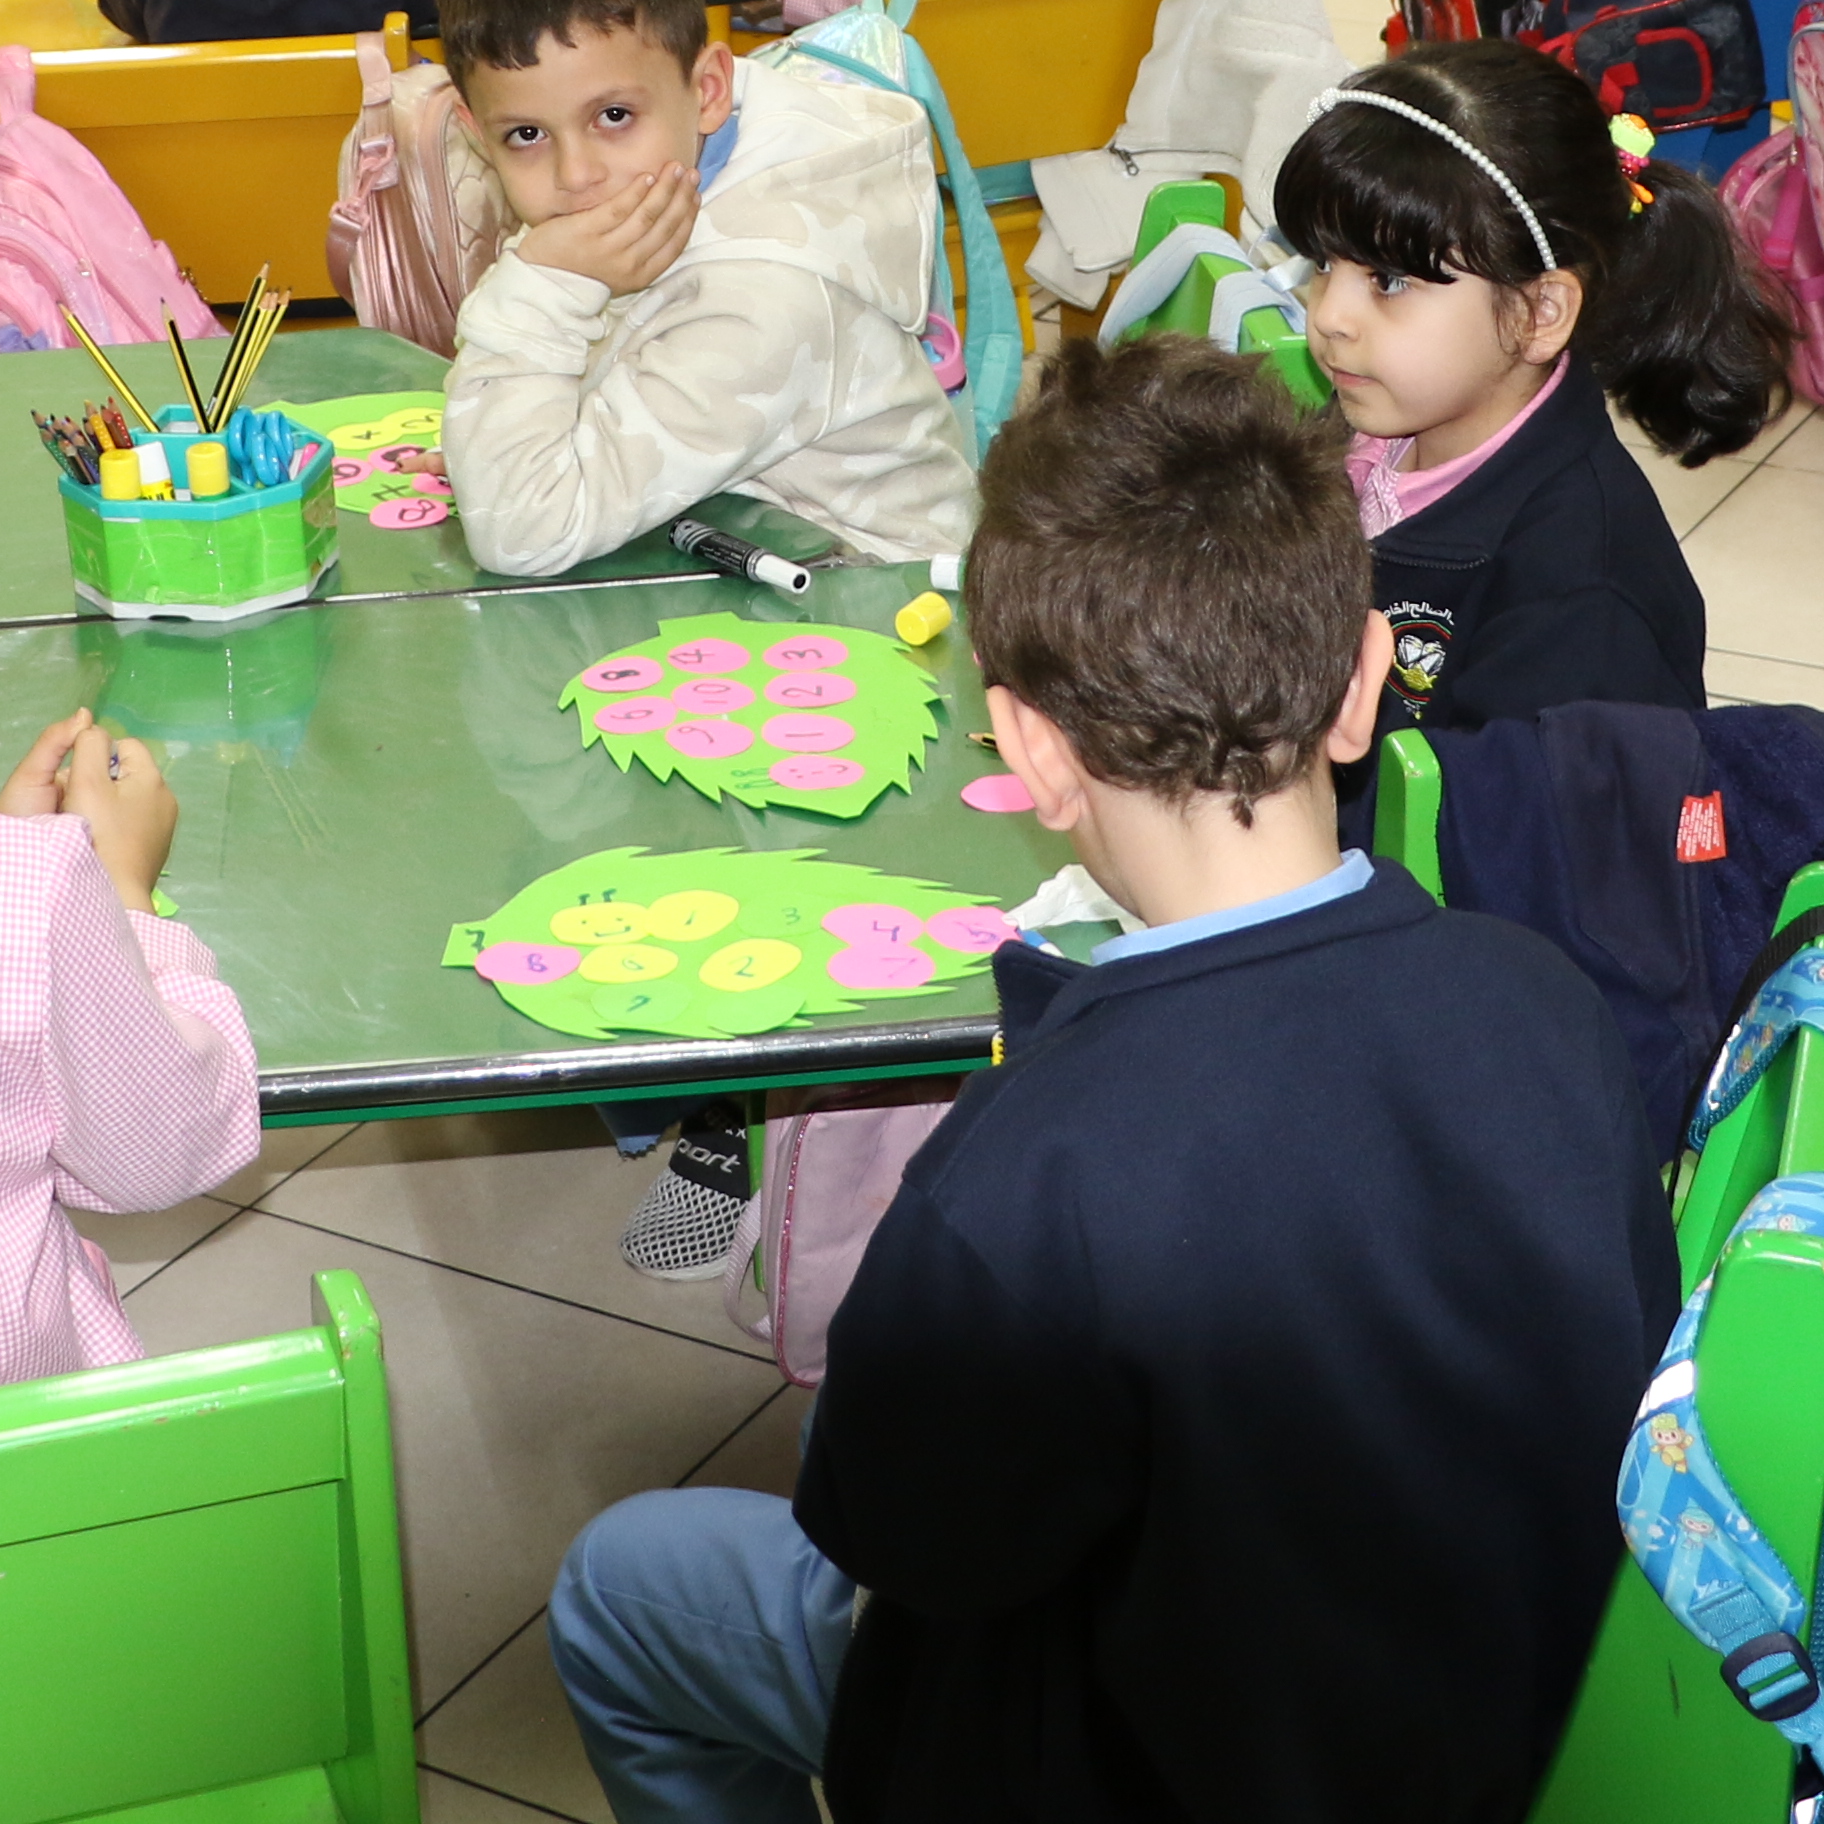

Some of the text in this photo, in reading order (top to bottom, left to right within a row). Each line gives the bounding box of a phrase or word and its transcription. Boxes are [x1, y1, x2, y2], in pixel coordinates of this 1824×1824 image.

[782, 647, 823, 660] 3
[781, 685, 823, 698] 2
[782, 906, 801, 925] 3
[873, 919, 900, 942] 4
[967, 919, 999, 945] 5
[727, 956, 755, 977] 2
